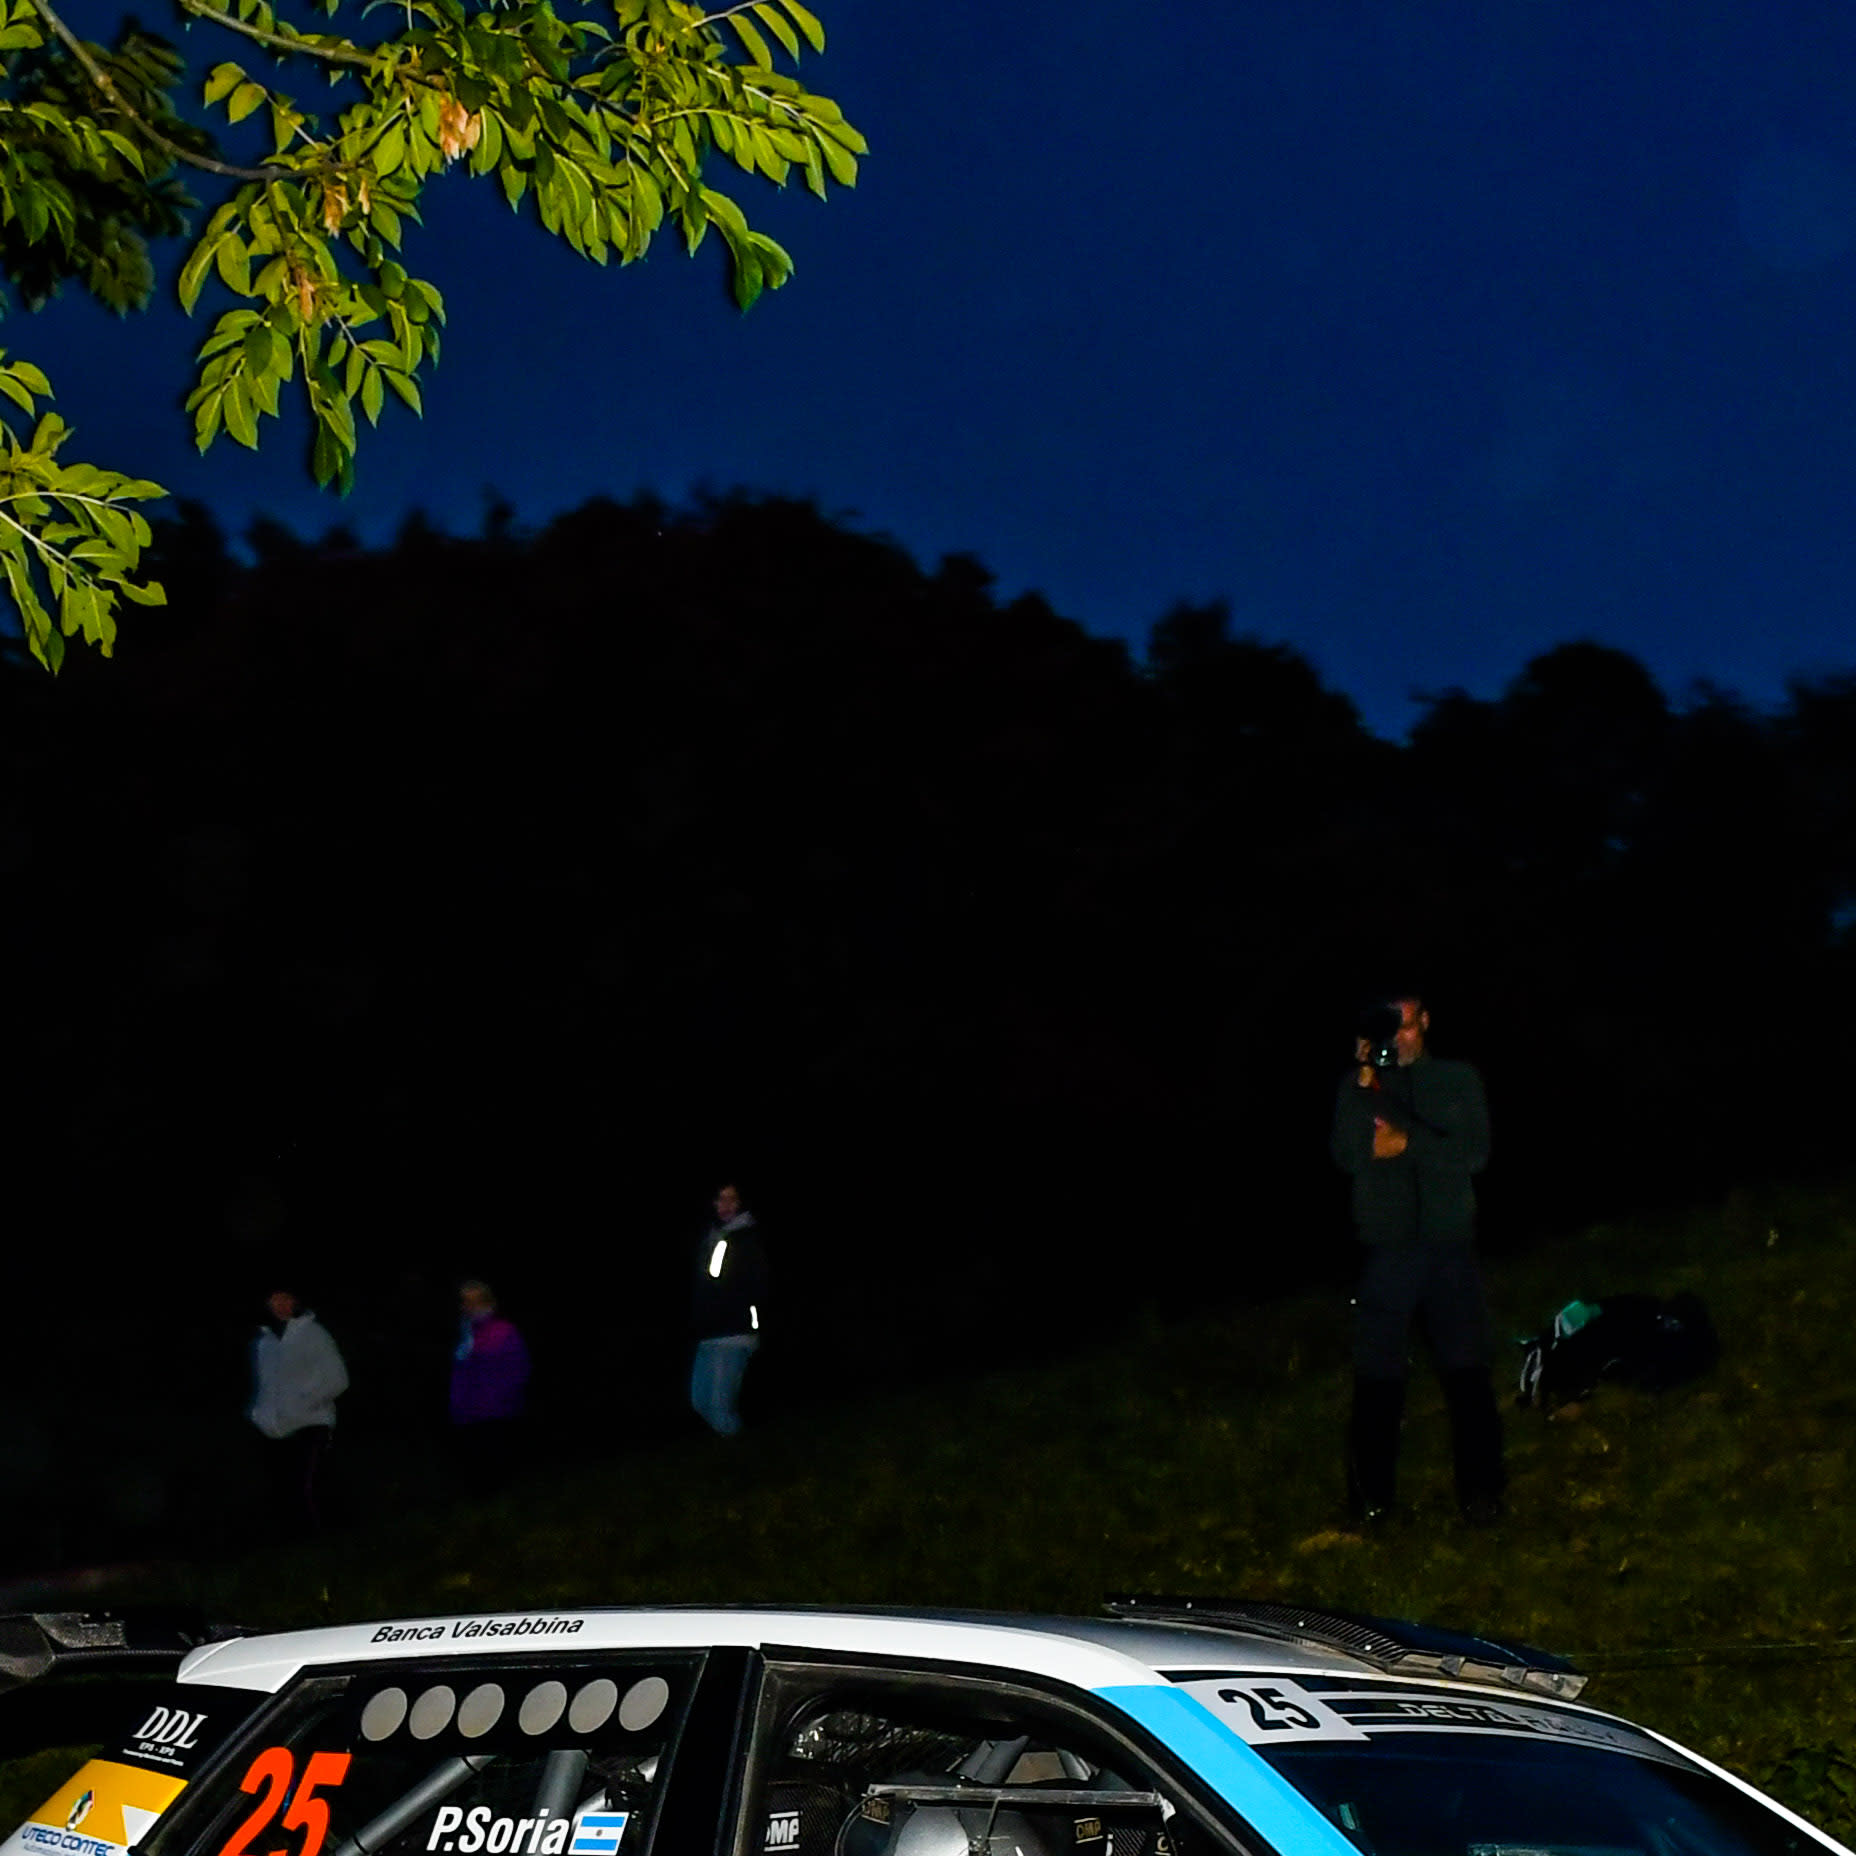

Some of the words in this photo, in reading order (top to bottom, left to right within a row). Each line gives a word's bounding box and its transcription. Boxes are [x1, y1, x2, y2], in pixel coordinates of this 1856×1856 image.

[371, 1626, 445, 1643] Banca
[452, 1617, 584, 1638] Valsabbina
[131, 1706, 208, 1749] DDL
[1218, 1688, 1321, 1731] 25
[426, 1806, 569, 1855] P.Soria
[764, 1819, 800, 1845] MP
